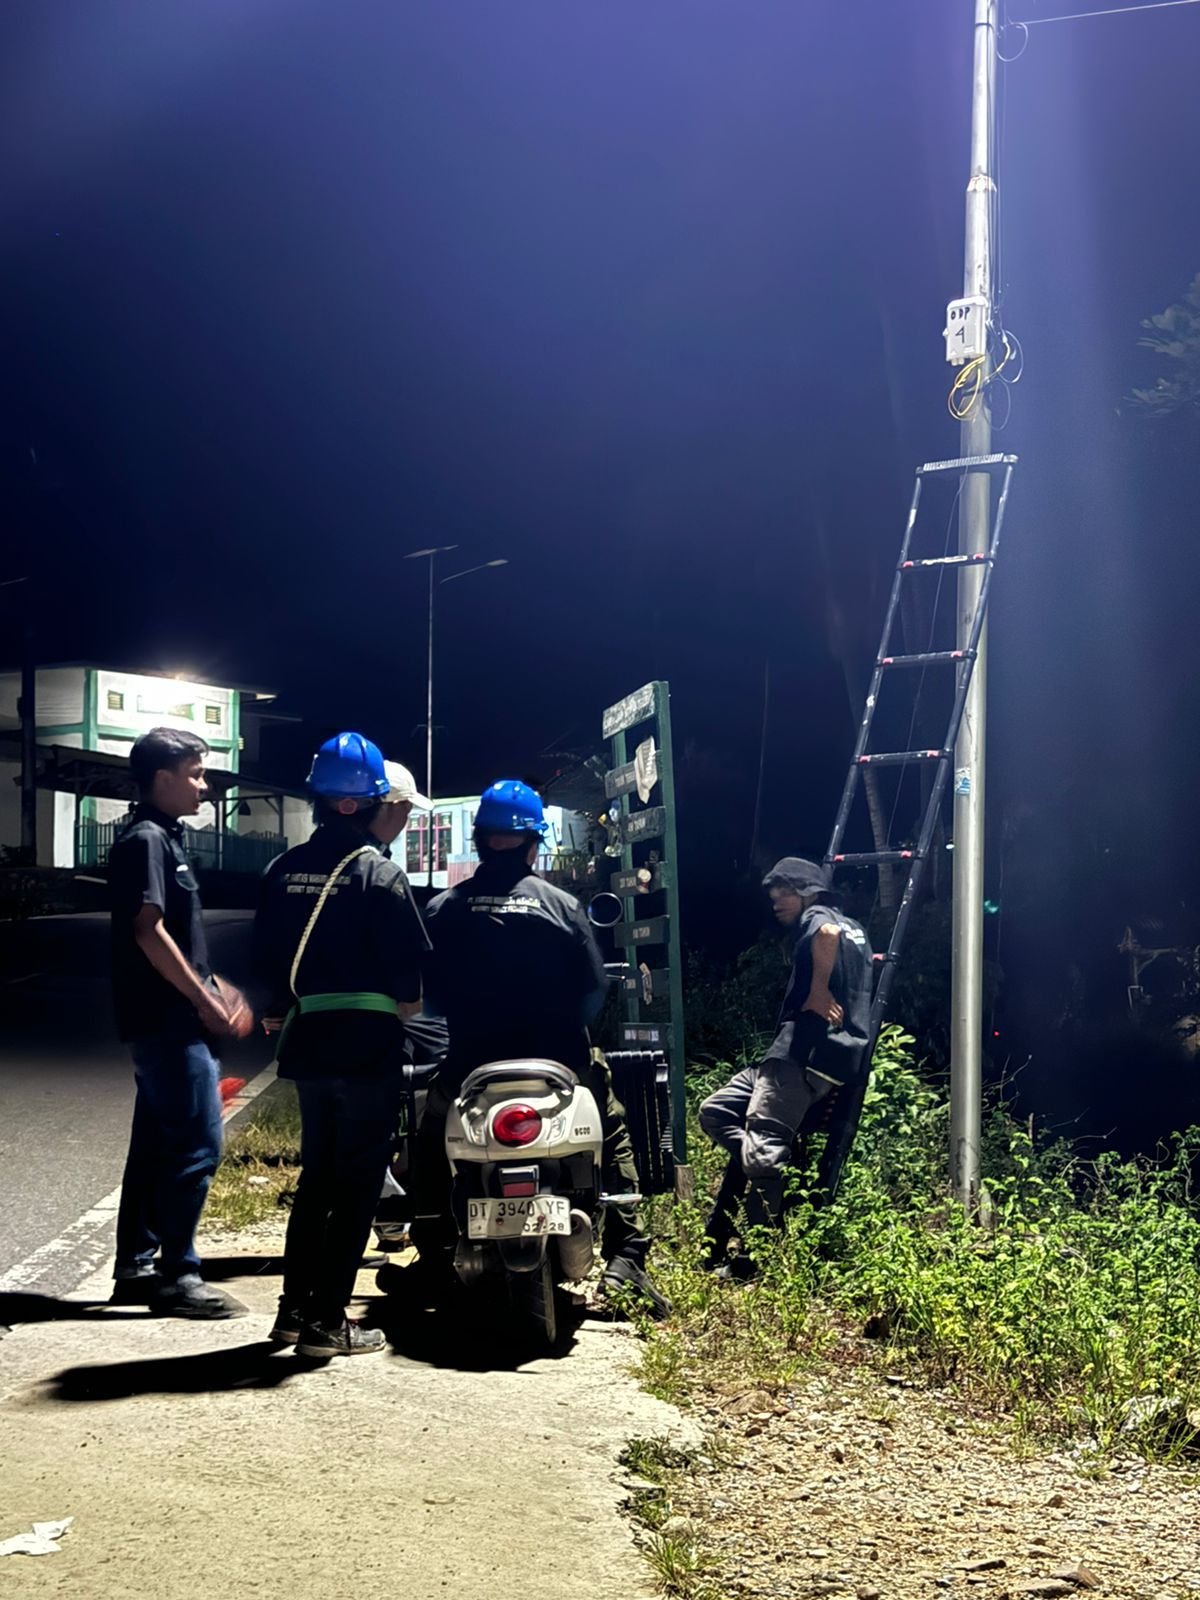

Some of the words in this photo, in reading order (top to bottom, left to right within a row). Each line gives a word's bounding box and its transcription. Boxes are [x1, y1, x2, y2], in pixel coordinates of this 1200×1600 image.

[955, 326, 965, 344] 4
[470, 1202, 487, 1218] DT
[498, 1201, 535, 1217] 3940
[546, 1201, 565, 1214] YF
